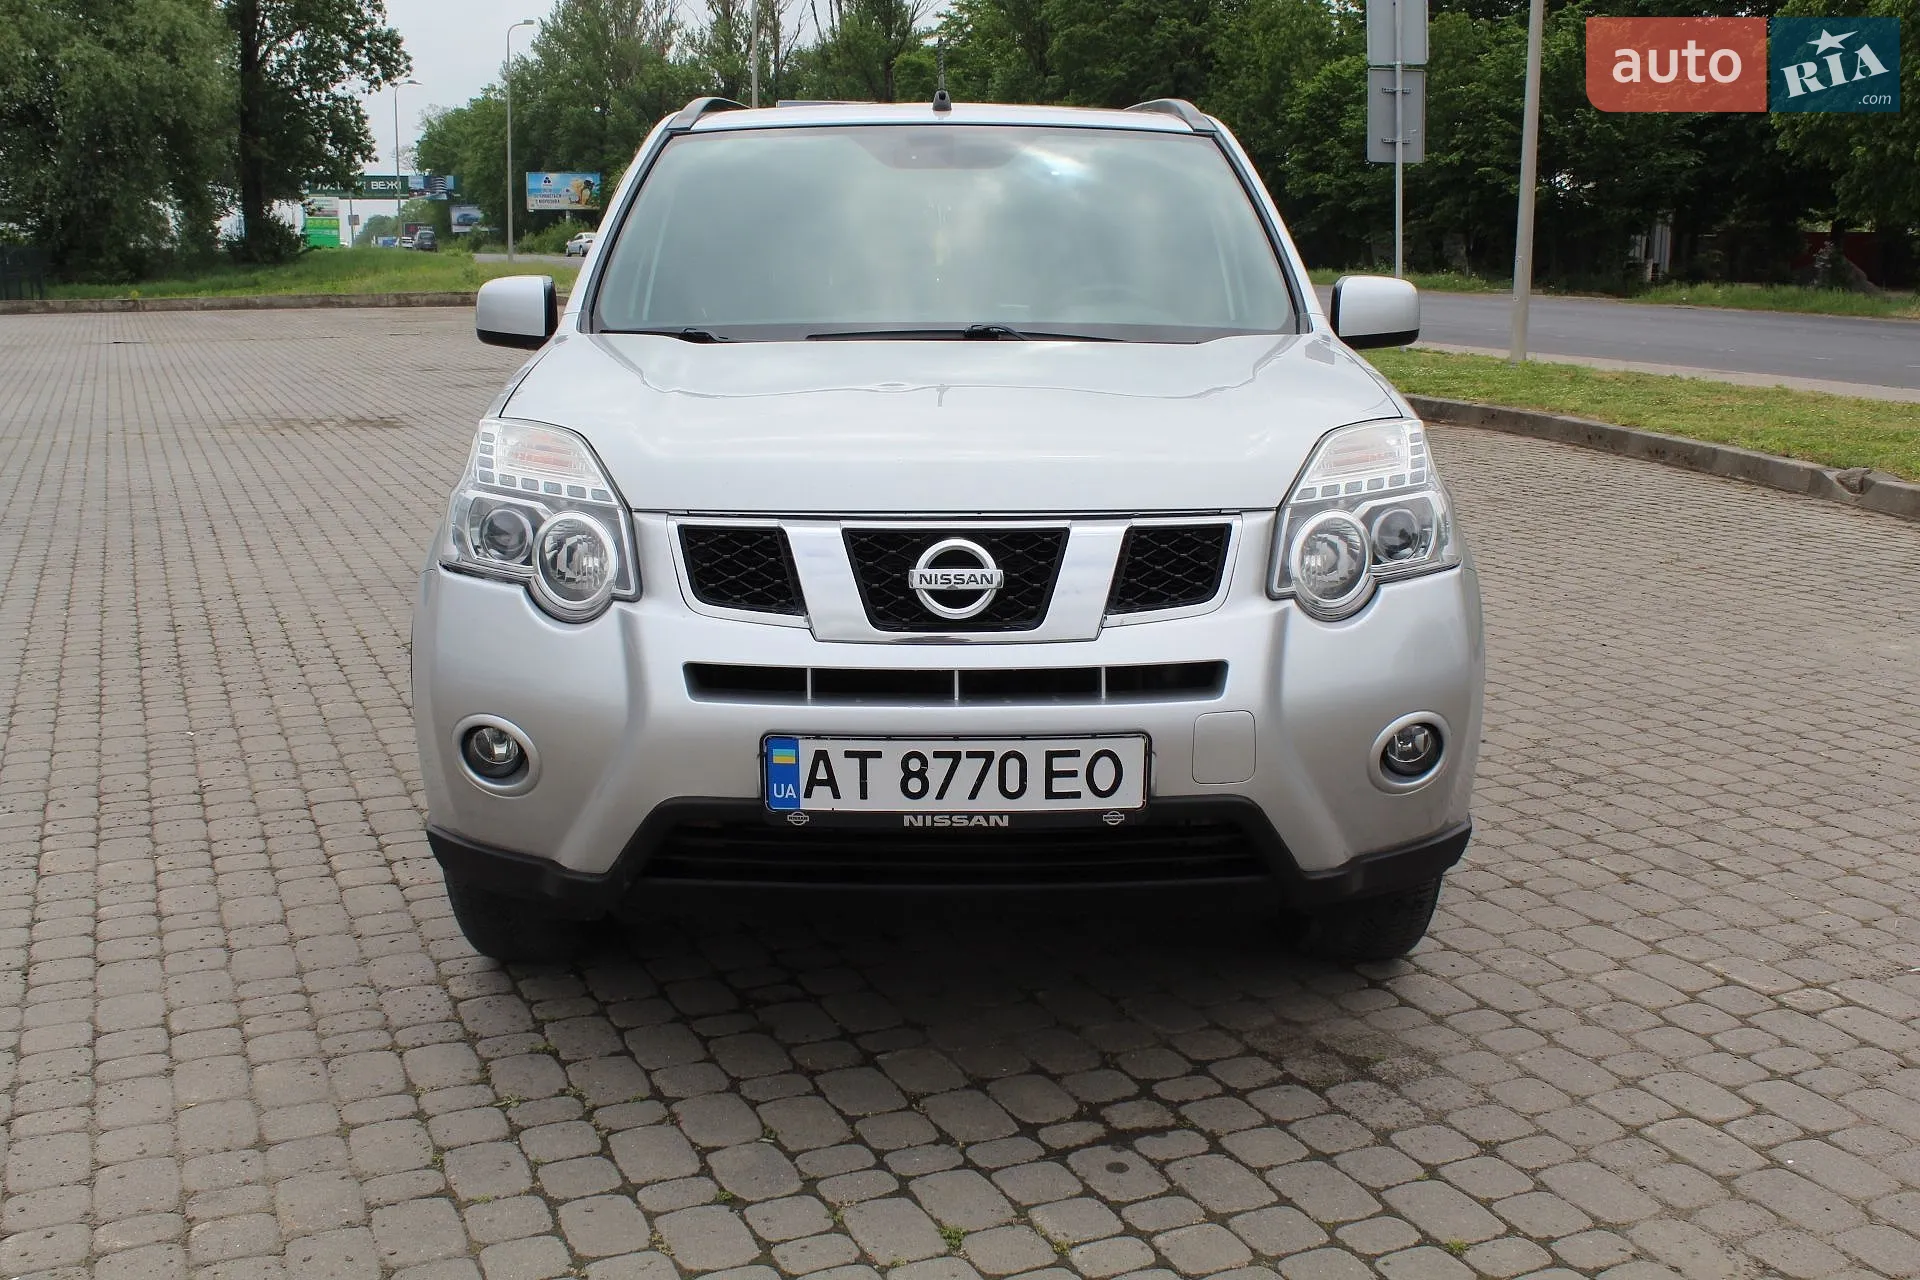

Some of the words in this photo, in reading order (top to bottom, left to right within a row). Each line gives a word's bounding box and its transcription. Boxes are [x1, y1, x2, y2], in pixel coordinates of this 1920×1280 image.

[919, 573, 994, 585] NISSAN
[803, 749, 883, 800] AT
[900, 749, 1028, 800] 8770
[1044, 749, 1124, 799] EO
[773, 783, 797, 798] UA
[903, 815, 1009, 827] NISSAN
